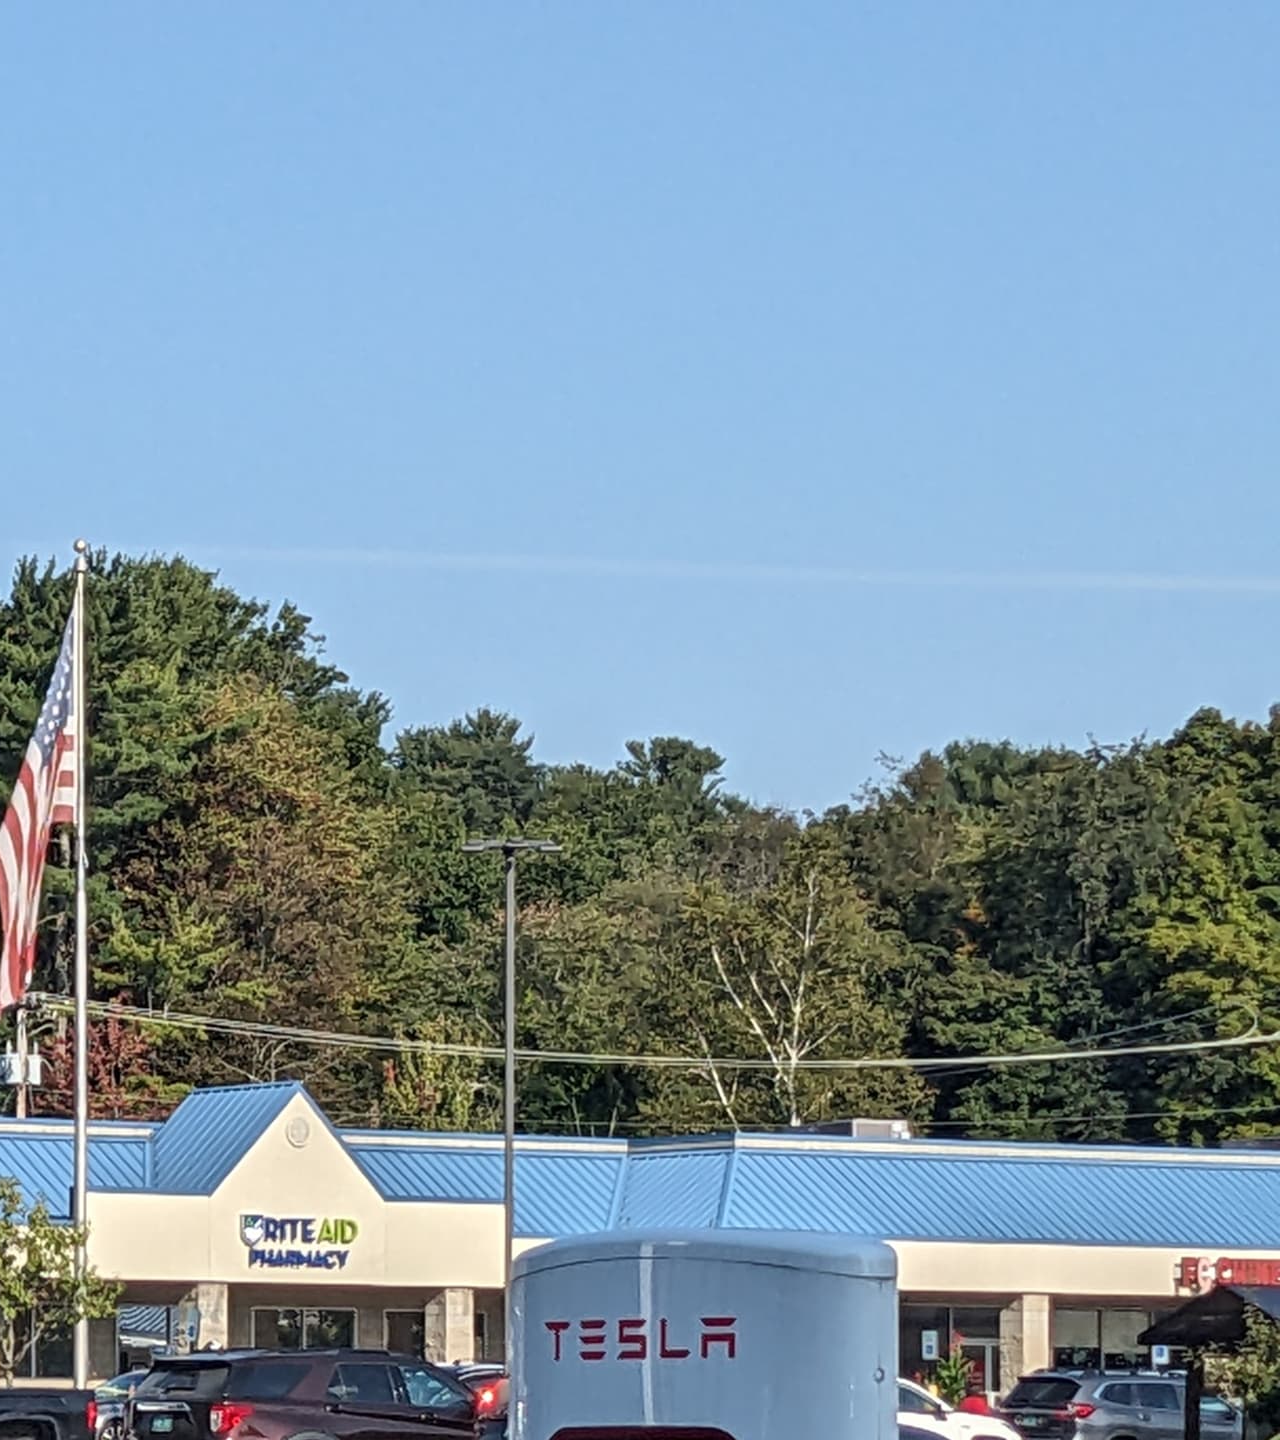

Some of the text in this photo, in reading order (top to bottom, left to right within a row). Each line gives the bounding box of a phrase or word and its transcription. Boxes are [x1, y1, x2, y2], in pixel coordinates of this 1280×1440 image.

[263, 1217, 358, 1245] RITE AID
[248, 1248, 349, 1270] PHARMACY
[544, 1317, 737, 1361] TESLA
